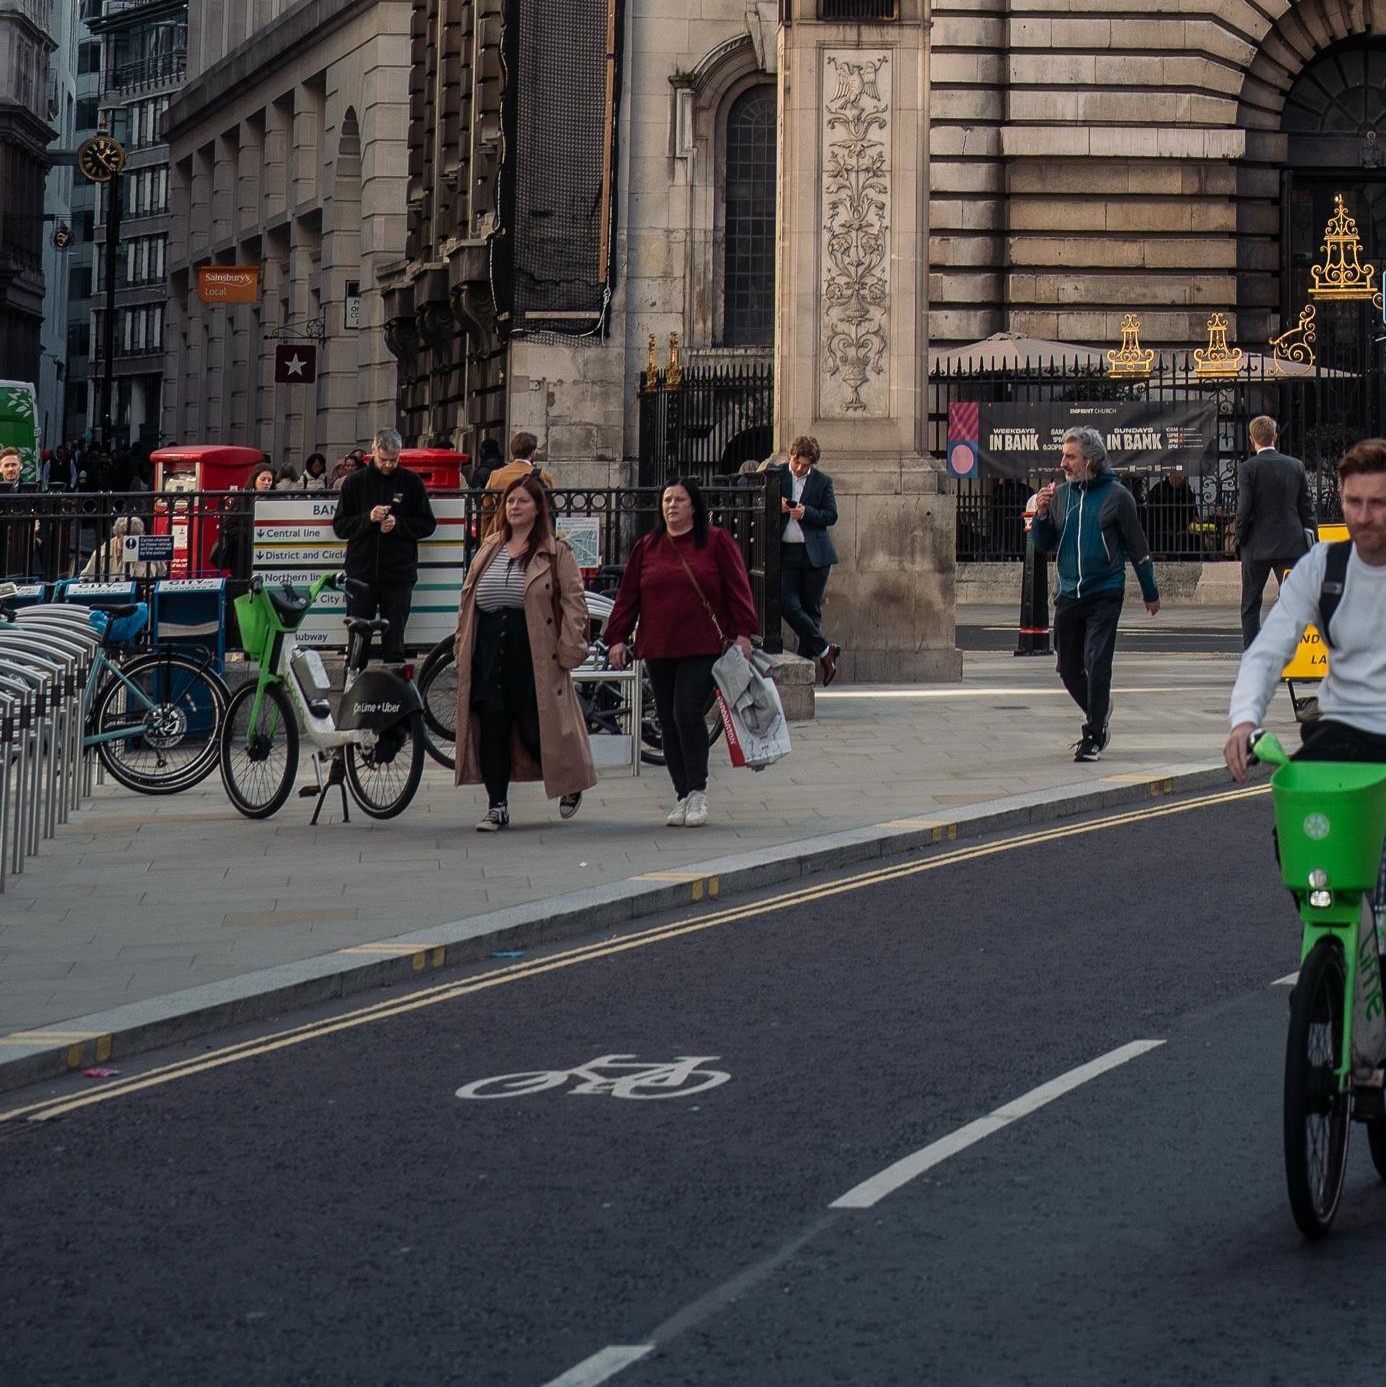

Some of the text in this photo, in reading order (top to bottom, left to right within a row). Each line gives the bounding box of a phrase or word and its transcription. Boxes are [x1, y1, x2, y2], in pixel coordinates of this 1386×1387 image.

[205, 273, 250, 283] Sainsbury's
[205, 287, 227, 296] Local
[989, 434, 1039, 451] IN BANK
[1107, 433, 1162, 450] IN BANK
[313, 505, 337, 516] BAN
[266, 529, 320, 538] Central line
[266, 550, 300, 560] District
[302, 551, 319, 560] and
[265, 573, 323, 582] Northern lin
[320, 593, 340, 604] City
[382, 702, 400, 713] Uber
